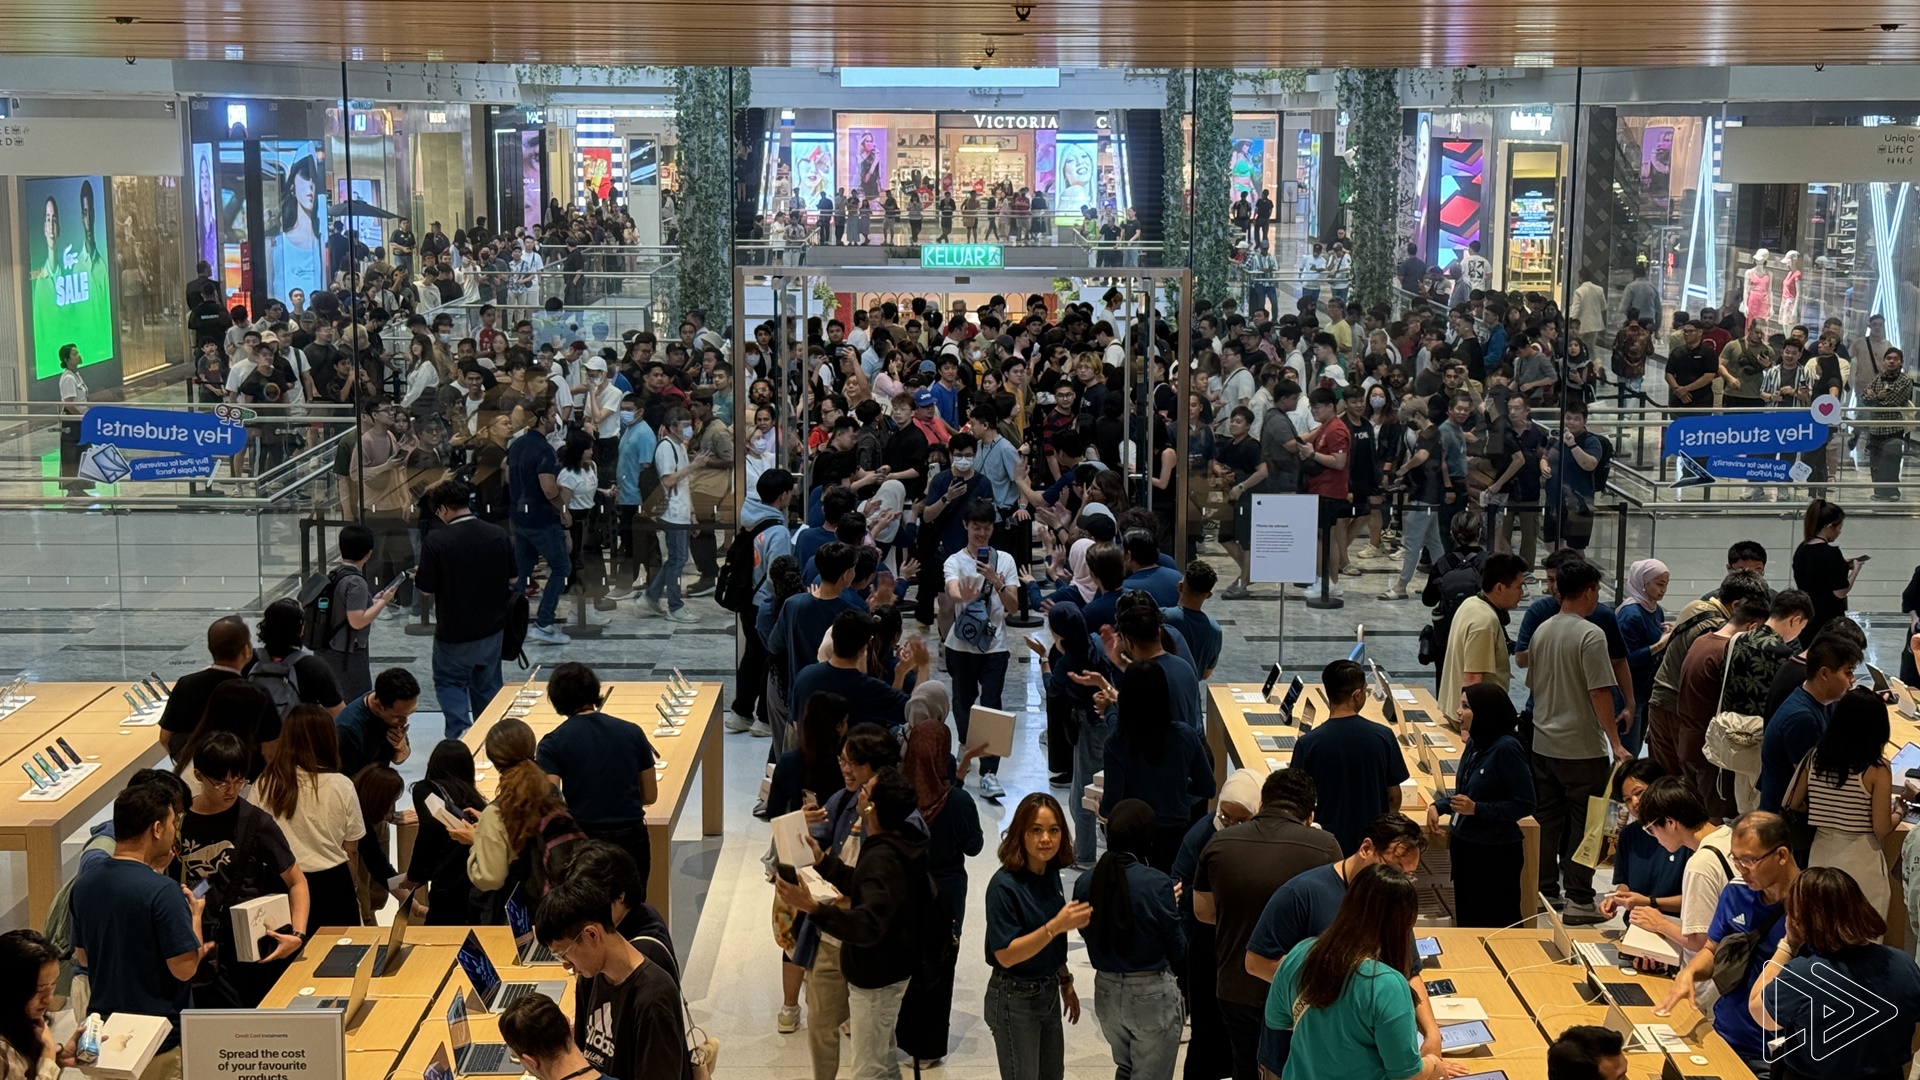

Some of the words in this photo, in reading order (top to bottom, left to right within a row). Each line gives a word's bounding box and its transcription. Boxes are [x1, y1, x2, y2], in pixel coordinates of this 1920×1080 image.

[973, 114, 1059, 129] VICTORIA
[1884, 134, 1915, 144] Uniqlo
[1888, 145, 1904, 154] Lift
[1906, 145, 1914, 154] C
[924, 245, 986, 266] KELUAR
[56, 271, 89, 307] SALE
[219, 1049, 259, 1061] Spread
[261, 1049, 279, 1059] the
[281, 1050, 306, 1059] cost
[218, 1061, 230, 1070] of
[231, 1063, 256, 1072] your
[258, 1061, 307, 1070] favourite
